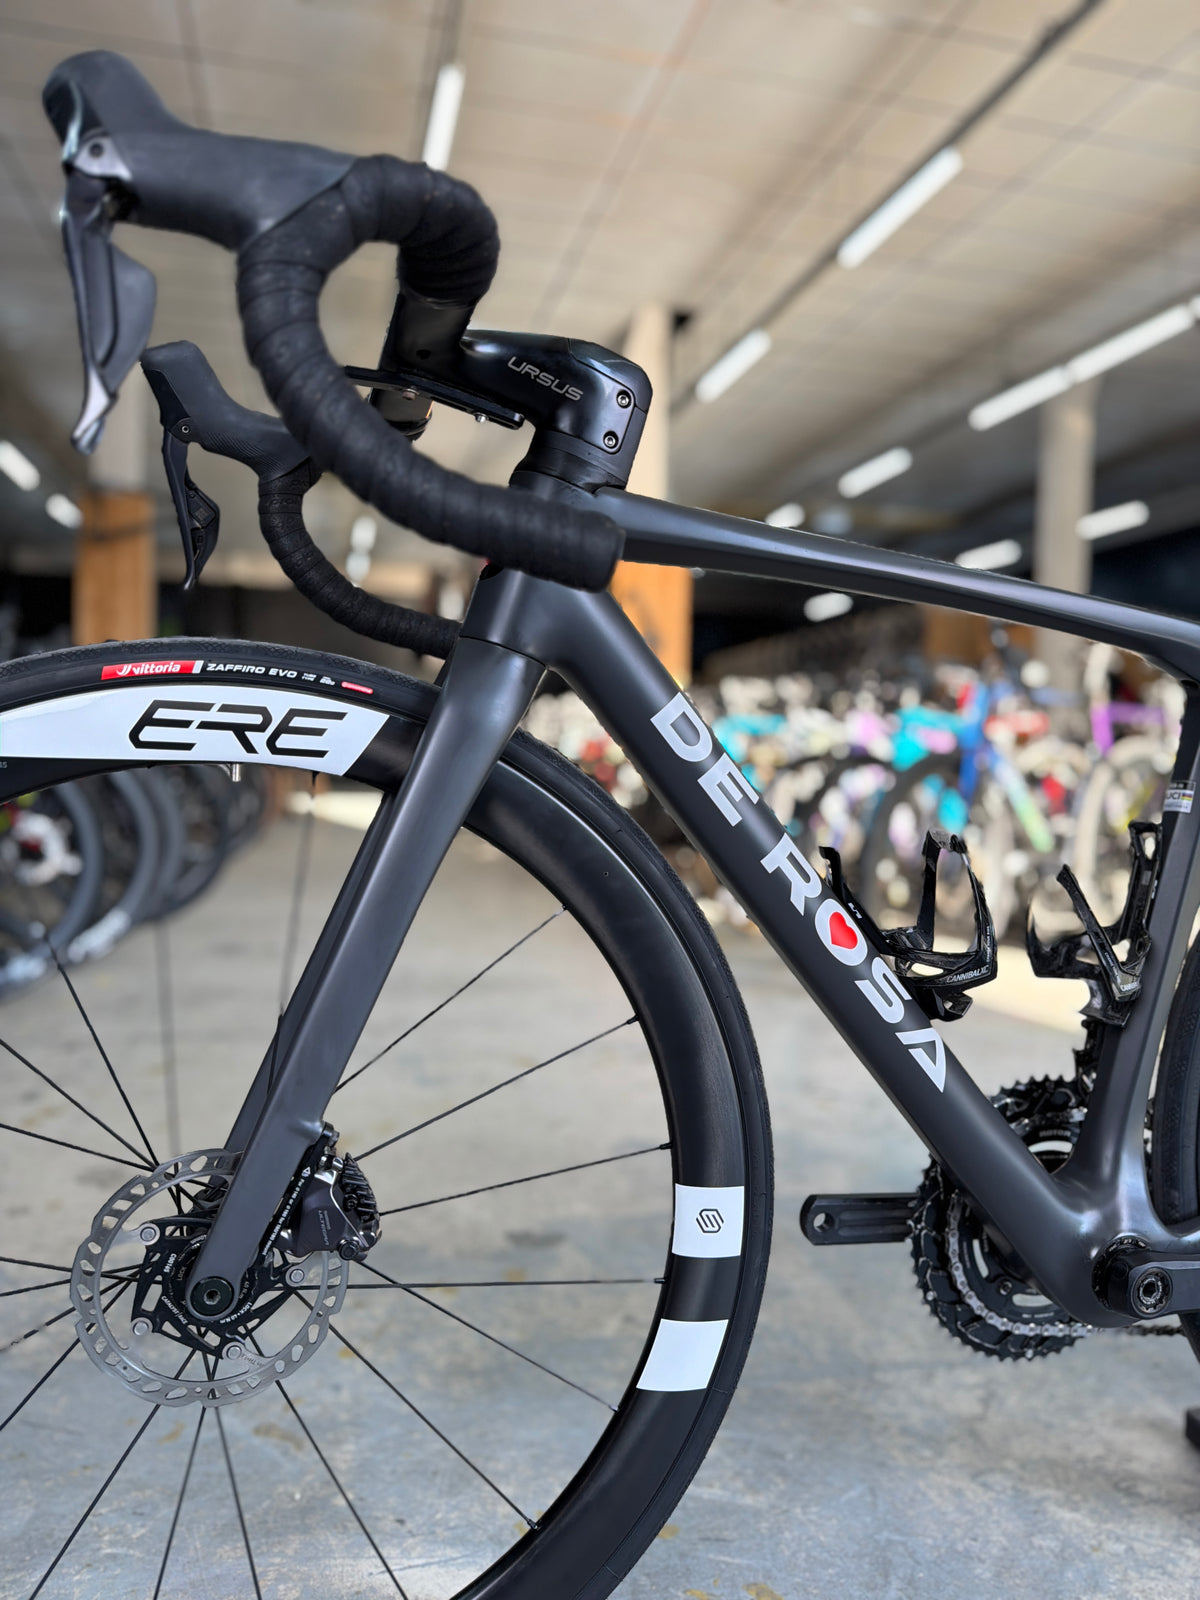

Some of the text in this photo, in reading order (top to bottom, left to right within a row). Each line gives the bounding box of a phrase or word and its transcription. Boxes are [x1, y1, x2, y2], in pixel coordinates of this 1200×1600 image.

[507, 356, 584, 401] URSUS
[132, 662, 298, 678] vittoria ZAFFIRO EVO
[128, 699, 348, 758] ERE
[650, 692, 946, 1093] DE ROSA
[947, 968, 981, 983] CANNIBAL
